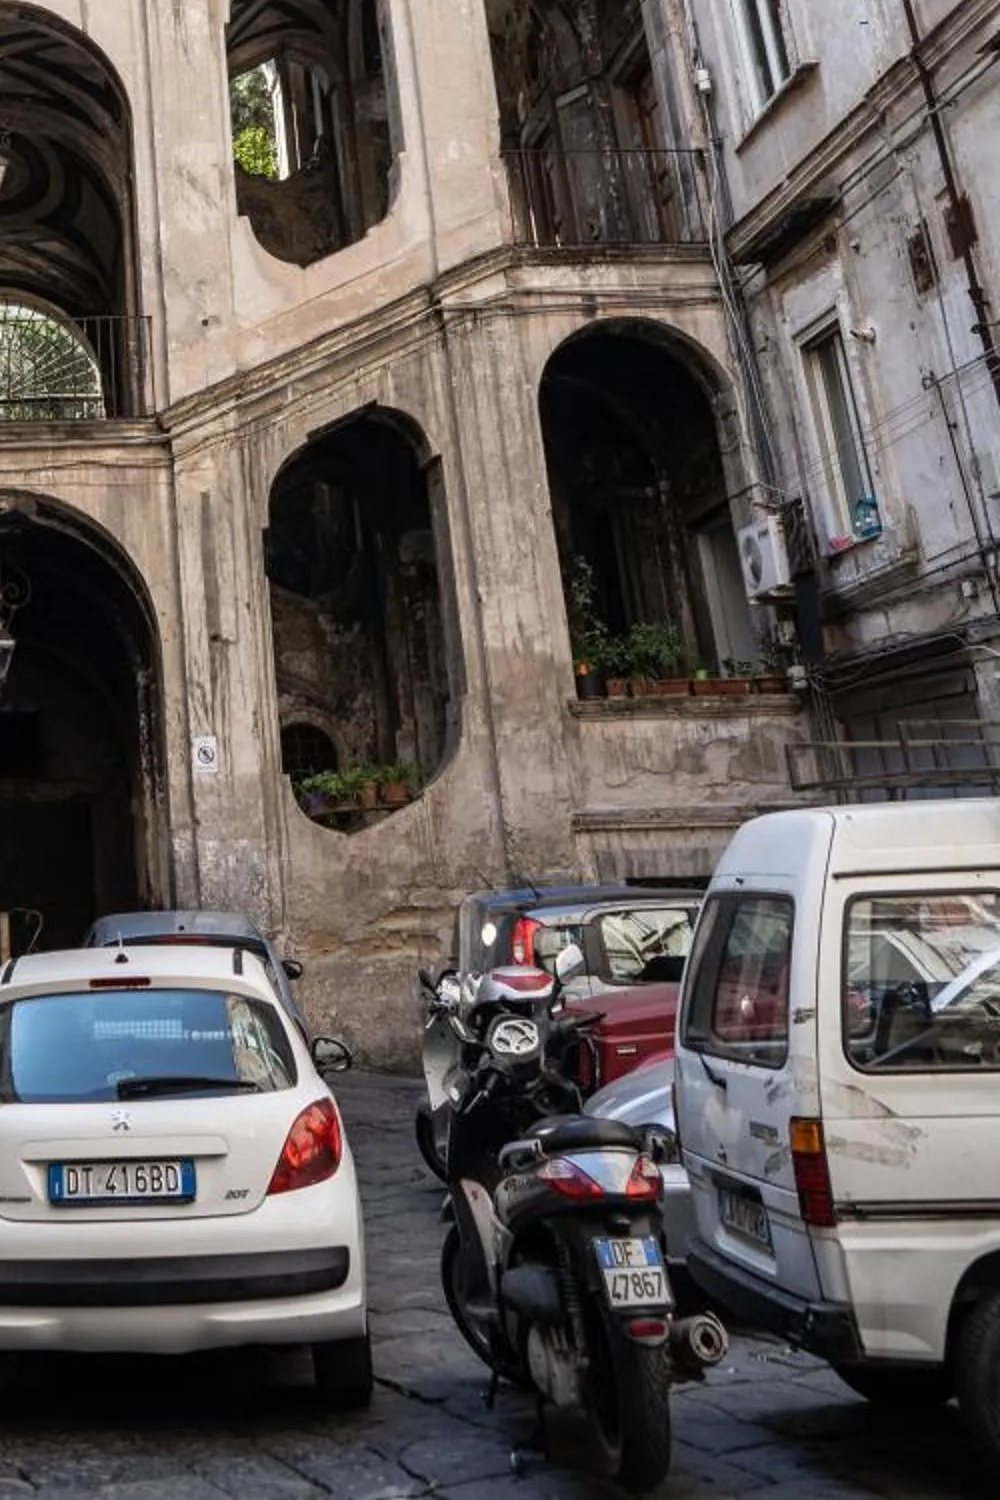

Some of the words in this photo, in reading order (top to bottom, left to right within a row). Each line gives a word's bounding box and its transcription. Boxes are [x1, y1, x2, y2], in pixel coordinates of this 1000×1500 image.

[67, 1167, 93, 1195] DT
[105, 1164, 179, 1194] 416BD
[611, 1241, 633, 1266] DF
[612, 1271, 662, 1301] 47867
